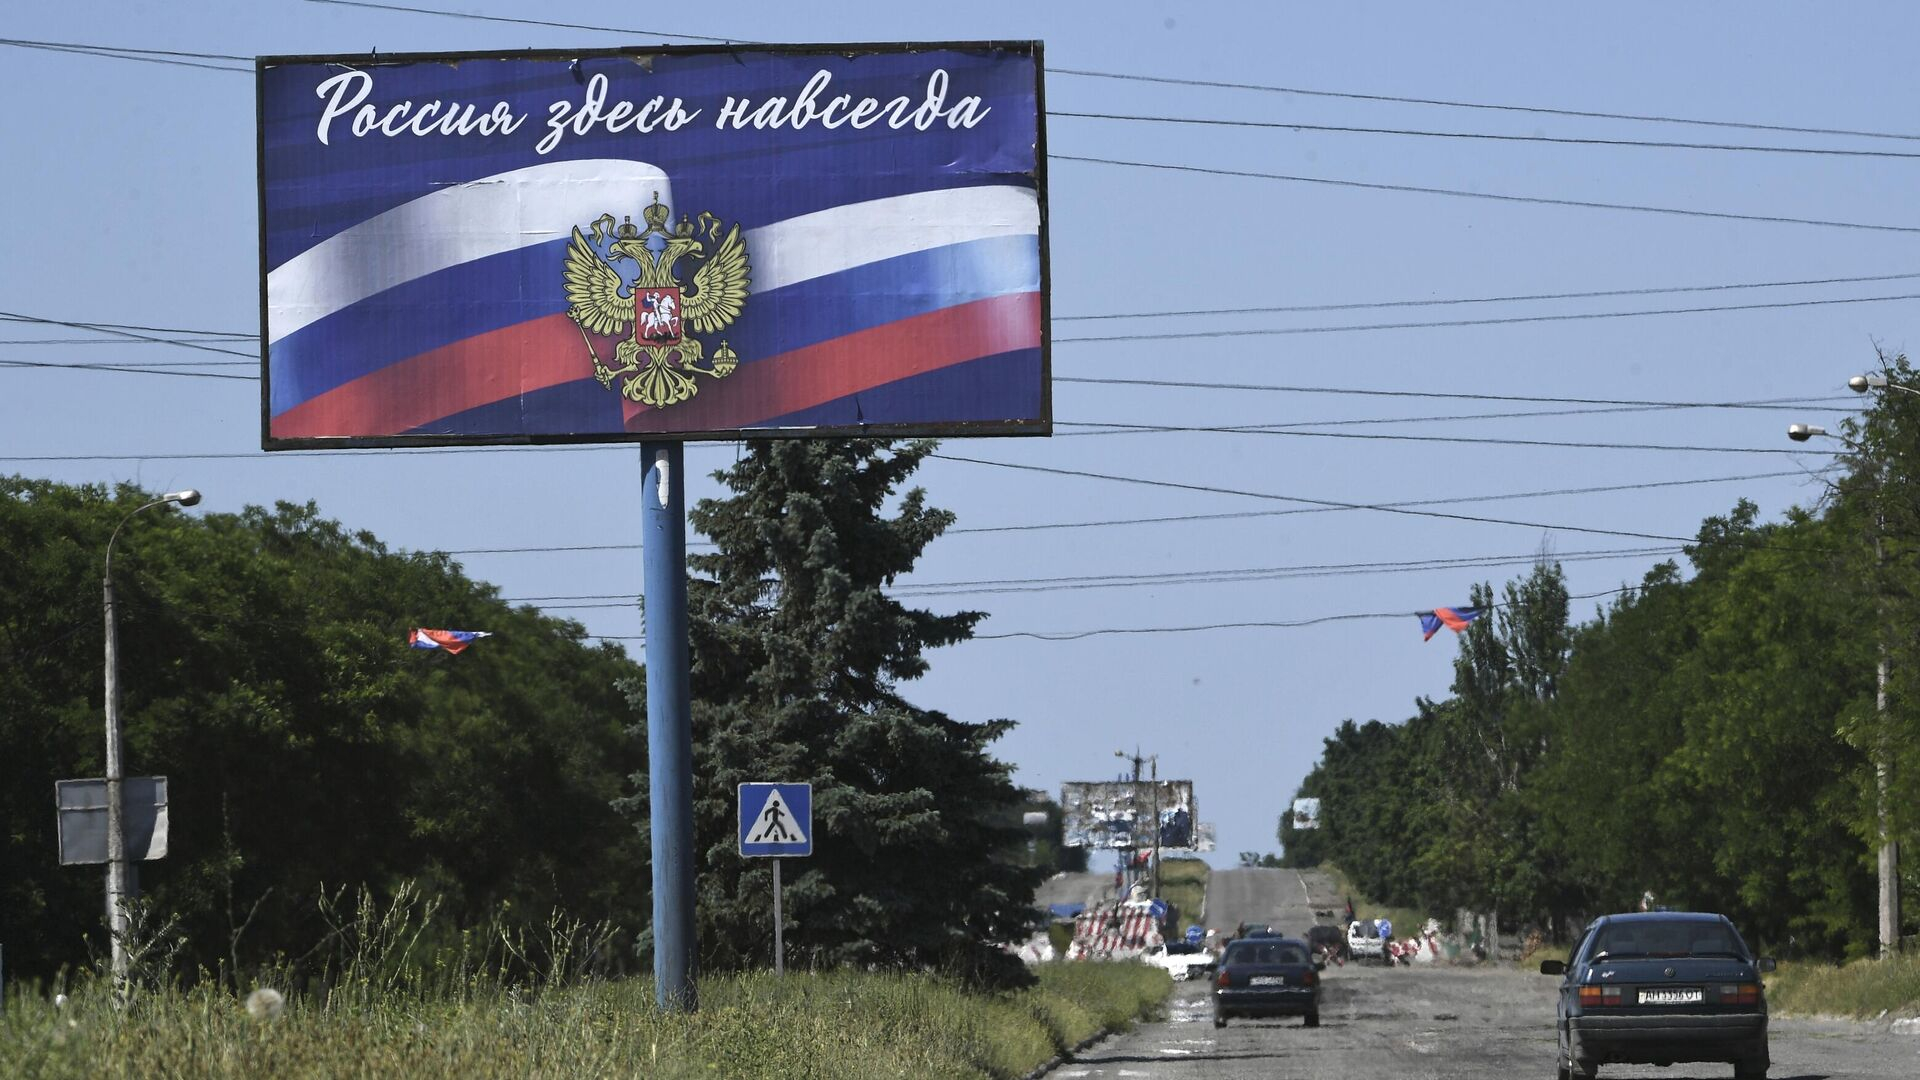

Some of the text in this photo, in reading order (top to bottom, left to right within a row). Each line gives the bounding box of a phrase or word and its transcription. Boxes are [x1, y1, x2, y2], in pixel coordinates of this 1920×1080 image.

[316, 68, 992, 155] Россия здесь навсегда
